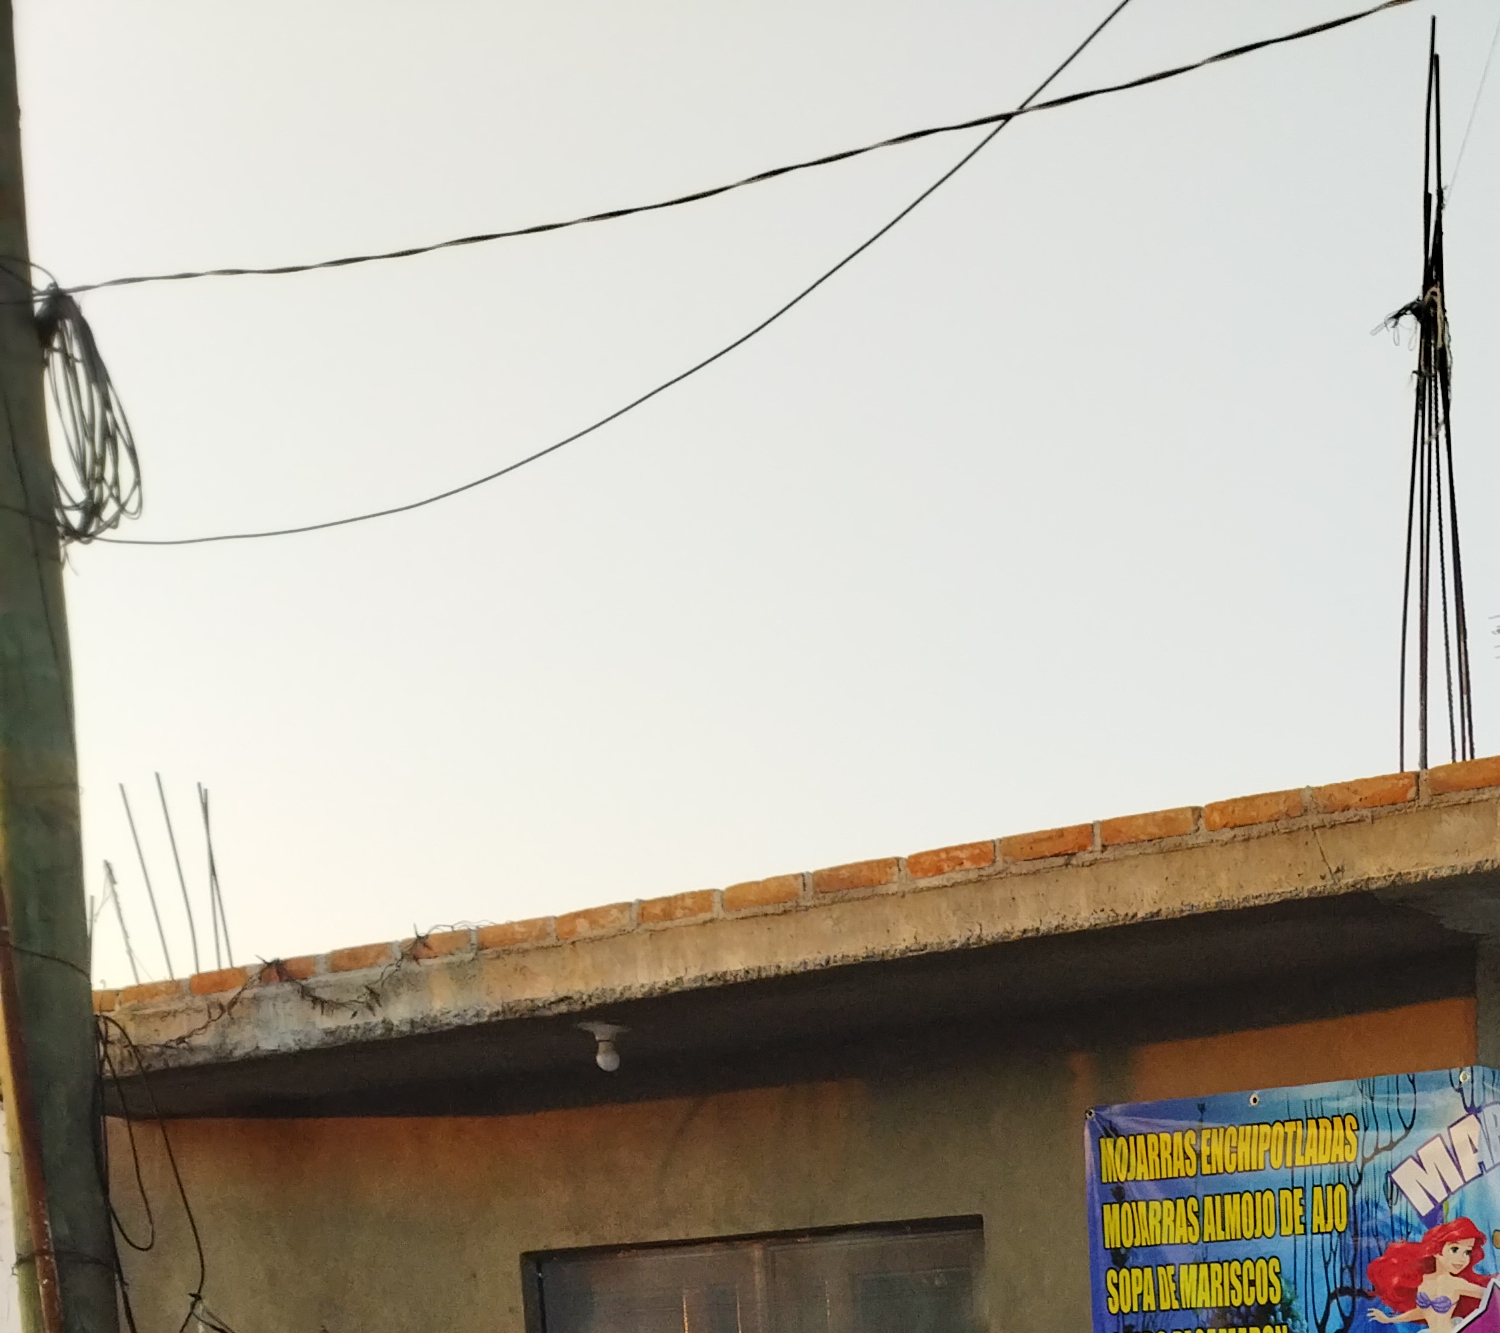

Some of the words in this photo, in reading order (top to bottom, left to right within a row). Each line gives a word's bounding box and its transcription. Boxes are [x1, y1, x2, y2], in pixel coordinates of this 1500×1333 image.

[1100, 1130, 1197, 1184] MOJARRAS
[1201, 1113, 1358, 1176] ENCHIPOTLADAS
[1102, 1196, 1199, 1249] MOJARRAS
[1279, 1187, 1305, 1236] DE
[1311, 1183, 1349, 1234] AJO
[1106, 1266, 1156, 1315] SOPA
[1157, 1264, 1179, 1311] DE
[1179, 1256, 1282, 1309] MARISCOS
